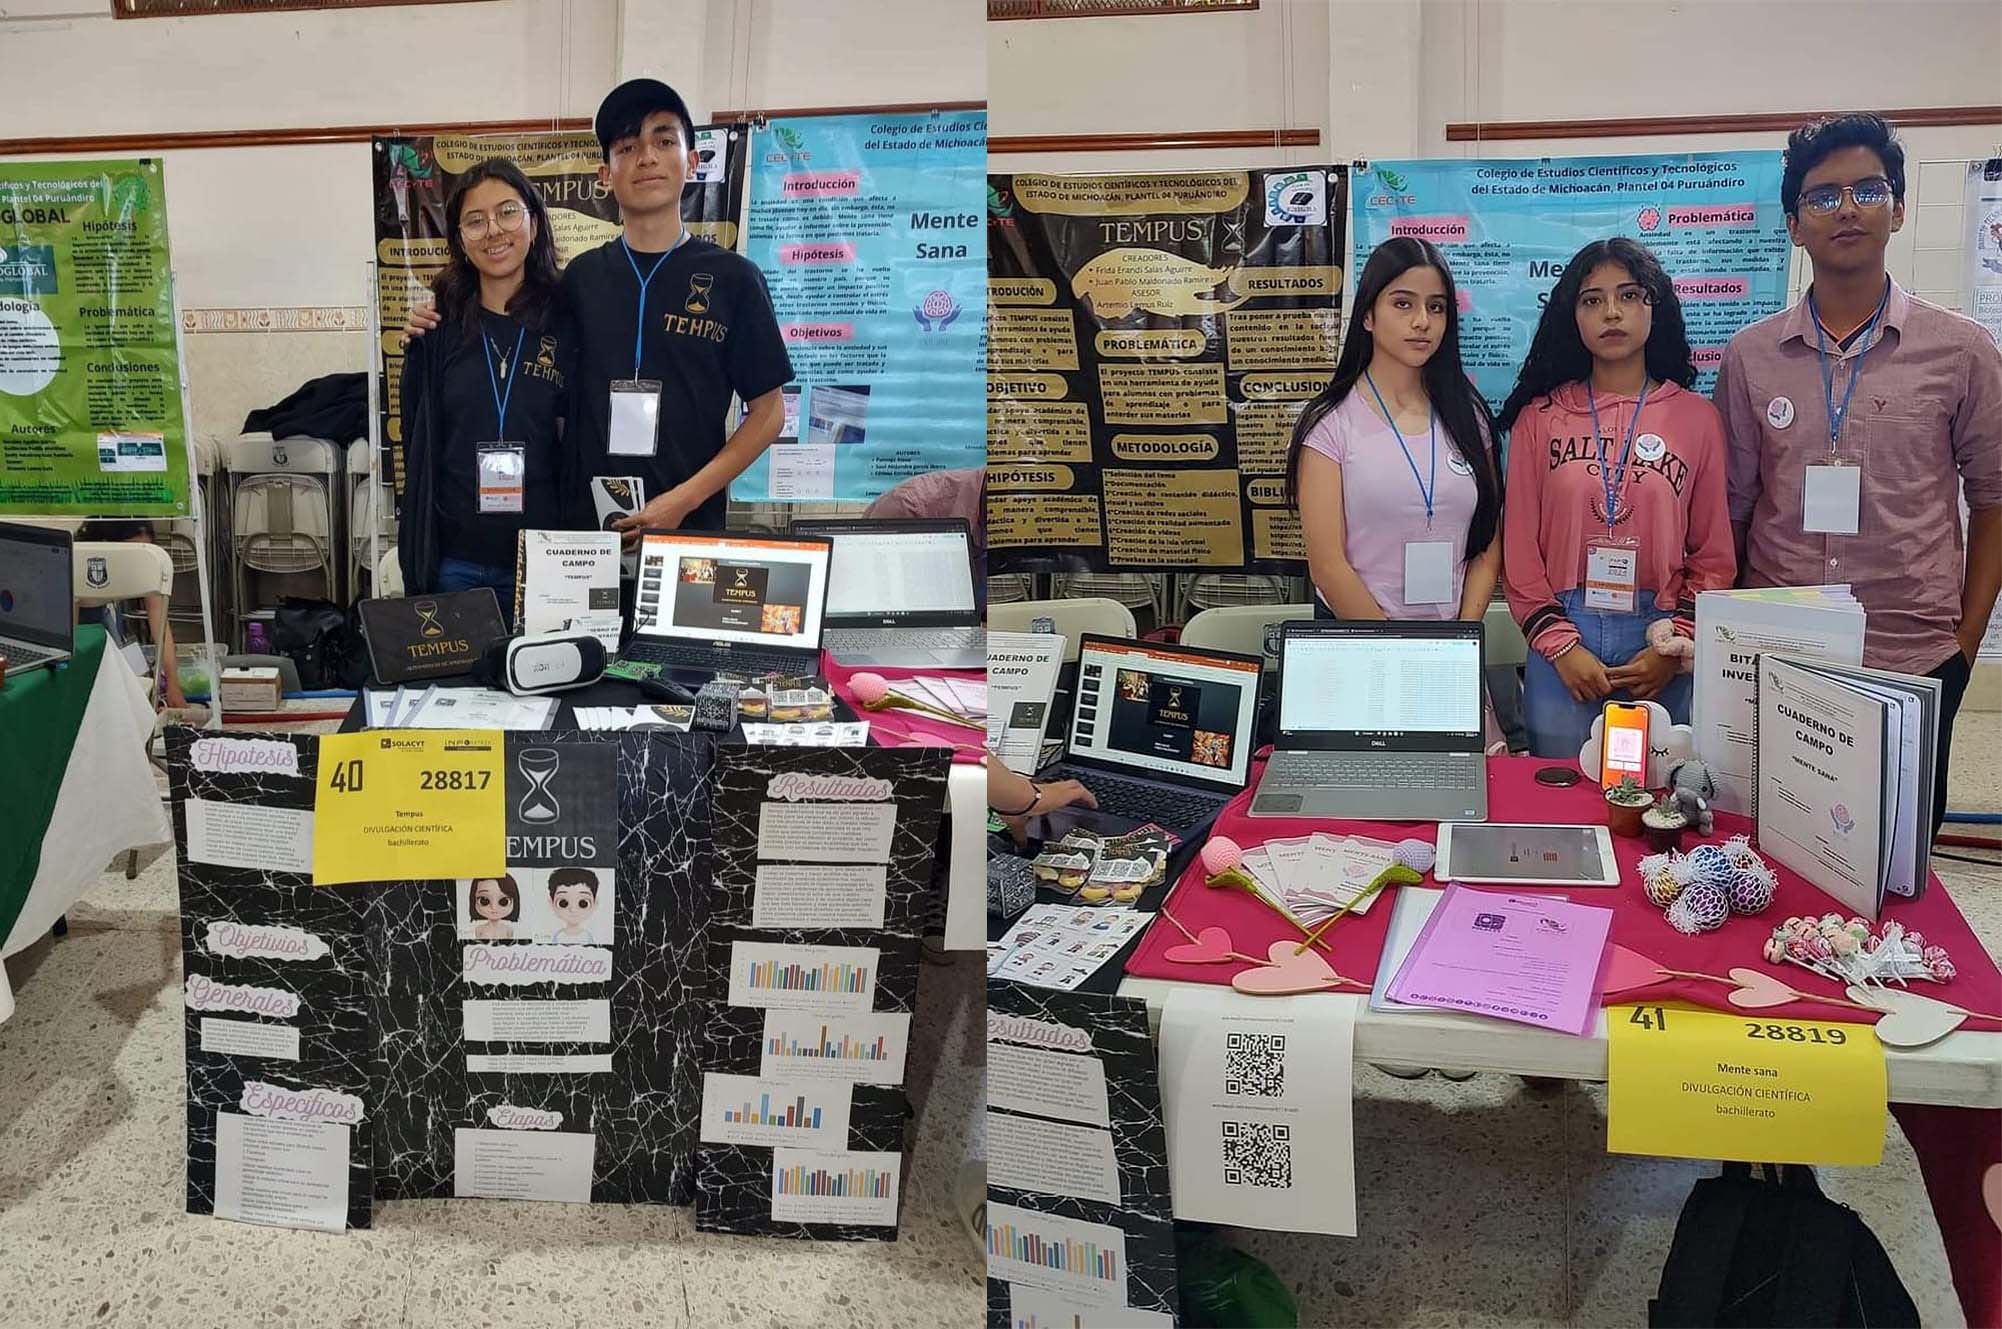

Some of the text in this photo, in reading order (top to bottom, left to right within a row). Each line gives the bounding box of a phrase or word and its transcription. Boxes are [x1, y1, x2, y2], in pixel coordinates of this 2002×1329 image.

[871, 122, 970, 136] Colegio de Estudios
[437, 141, 467, 150] COLEGIO
[469, 142, 478, 151] DE
[480, 143, 515, 152] ESTUDIOS
[517, 141, 561, 151] CIENTÍFICOS
[864, 139, 932, 150] del Estado de
[447, 152, 475, 161] ESTADO
[1477, 162, 1737, 181] Colegio de Estudios Científicos y Tecnológicos
[783, 179, 855, 191] Introducción
[1015, 177, 1237, 190] COLEGIO DE ESTUDIOS CIENTÍFICOS Y TECNOLÓGICOS DEL
[1472, 177, 1745, 195] del Estado de Michoacán, Plantel 04 Puruándiro
[1026, 190, 1056, 200] ESTADO
[1058, 192, 1068, 201] DE
[1125, 190, 1160, 200] PLANTEL
[1173, 188, 1227, 199] PURUÁNDIRO
[911, 212, 979, 230] Mente
[1668, 209, 1754, 224] Problemática
[82, 220, 138, 233] Hipótesis
[573, 224, 600, 233] Aguirre
[1099, 219, 1203, 243] TEMPUS
[1391, 223, 1466, 236] Introducción
[792, 249, 844, 262] Hipótesis
[915, 243, 968, 260] Sana
[1122, 254, 1168, 263] CREADORES
[1096, 265, 1192, 276] Frida Erandi Salas Aguirre
[1095, 277, 1182, 287] Juan Pablo Maldonado
[1248, 278, 1324, 290] RESULTADOS
[1674, 280, 1742, 294] Resultados
[1132, 288, 1160, 298] ASESOR
[1097, 300, 1173, 309] Artemio Lemus Ruiz
[80, 306, 156, 319] Problemática
[1229, 312, 1311, 323] Tras poner prueba
[664, 313, 729, 343] TEMPUS
[790, 328, 843, 339] Objetivos
[1230, 323, 1272, 333] contenido
[1295, 323, 1304, 331] la
[1103, 336, 1197, 351] PROBLEMÁTICA
[1230, 333, 1314, 343] nuestros resultados
[1231, 345, 1241, 353] de
[1261, 344, 1315, 353] conocimiento
[1244, 355, 1300, 365] conocimiento
[87, 361, 160, 374] Conclusiones
[1111, 368, 1218, 378] proyecto TEMPUS consiste
[987, 382, 1047, 394] OBJETIVO
[1129, 378, 1182, 387] herramienta
[1182, 379, 1191, 387] de
[1193, 379, 1219, 388] ayuda
[1103, 391, 1120, 399] para
[1123, 389, 1156, 397] alumnos
[1176, 388, 1219, 399] problemas
[1125, 400, 1220, 410] aprendizaje para
[1155, 410, 1191, 418] materias
[11, 423, 58, 434] Autores
[1117, 439, 1214, 454] METODOLOGÍA
[1550, 436, 1614, 472] SALT
[988, 469, 1055, 483] HIPÓTESIS
[1587, 463, 1650, 484] CITY
[546, 548, 612, 557] CUADERNO DE
[562, 560, 595, 568] CAMPO
[725, 588, 756, 598] TEMPUS
[407, 640, 469, 657] TEMPUS
[1036, 654, 1050, 663] DE
[992, 666, 1029, 675] CAMPO
[1159, 708, 1189, 721] TEMPUS
[1777, 704, 1836, 738] CUADERNO
[1839, 732, 1854, 748] DE
[392, 740, 425, 748] SOLACYT
[1796, 730, 1834, 755] CAMPO
[330, 759, 492, 793] 40 28817
[773, 774, 888, 800] Resultados
[395, 810, 424, 819] Tempus
[363, 822, 453, 834] DIVULGACIÓN CIENTÍFICA
[387, 838, 429, 848] bachillerato
[507, 836, 597, 859] EMPUS
[464, 947, 607, 976] Problemática
[190, 976, 293, 1015] Generales
[1629, 1006, 1847, 1045] 41 28819
[987, 1018, 1086, 1049] esultados
[1717, 1062, 1778, 1078] Mente sana
[1682, 1081, 1811, 1102] DIVULGACIÓN CIENTÍFICA
[497, 1107, 554, 1128] Etapas
[1716, 1103, 1776, 1119] bachillerato
